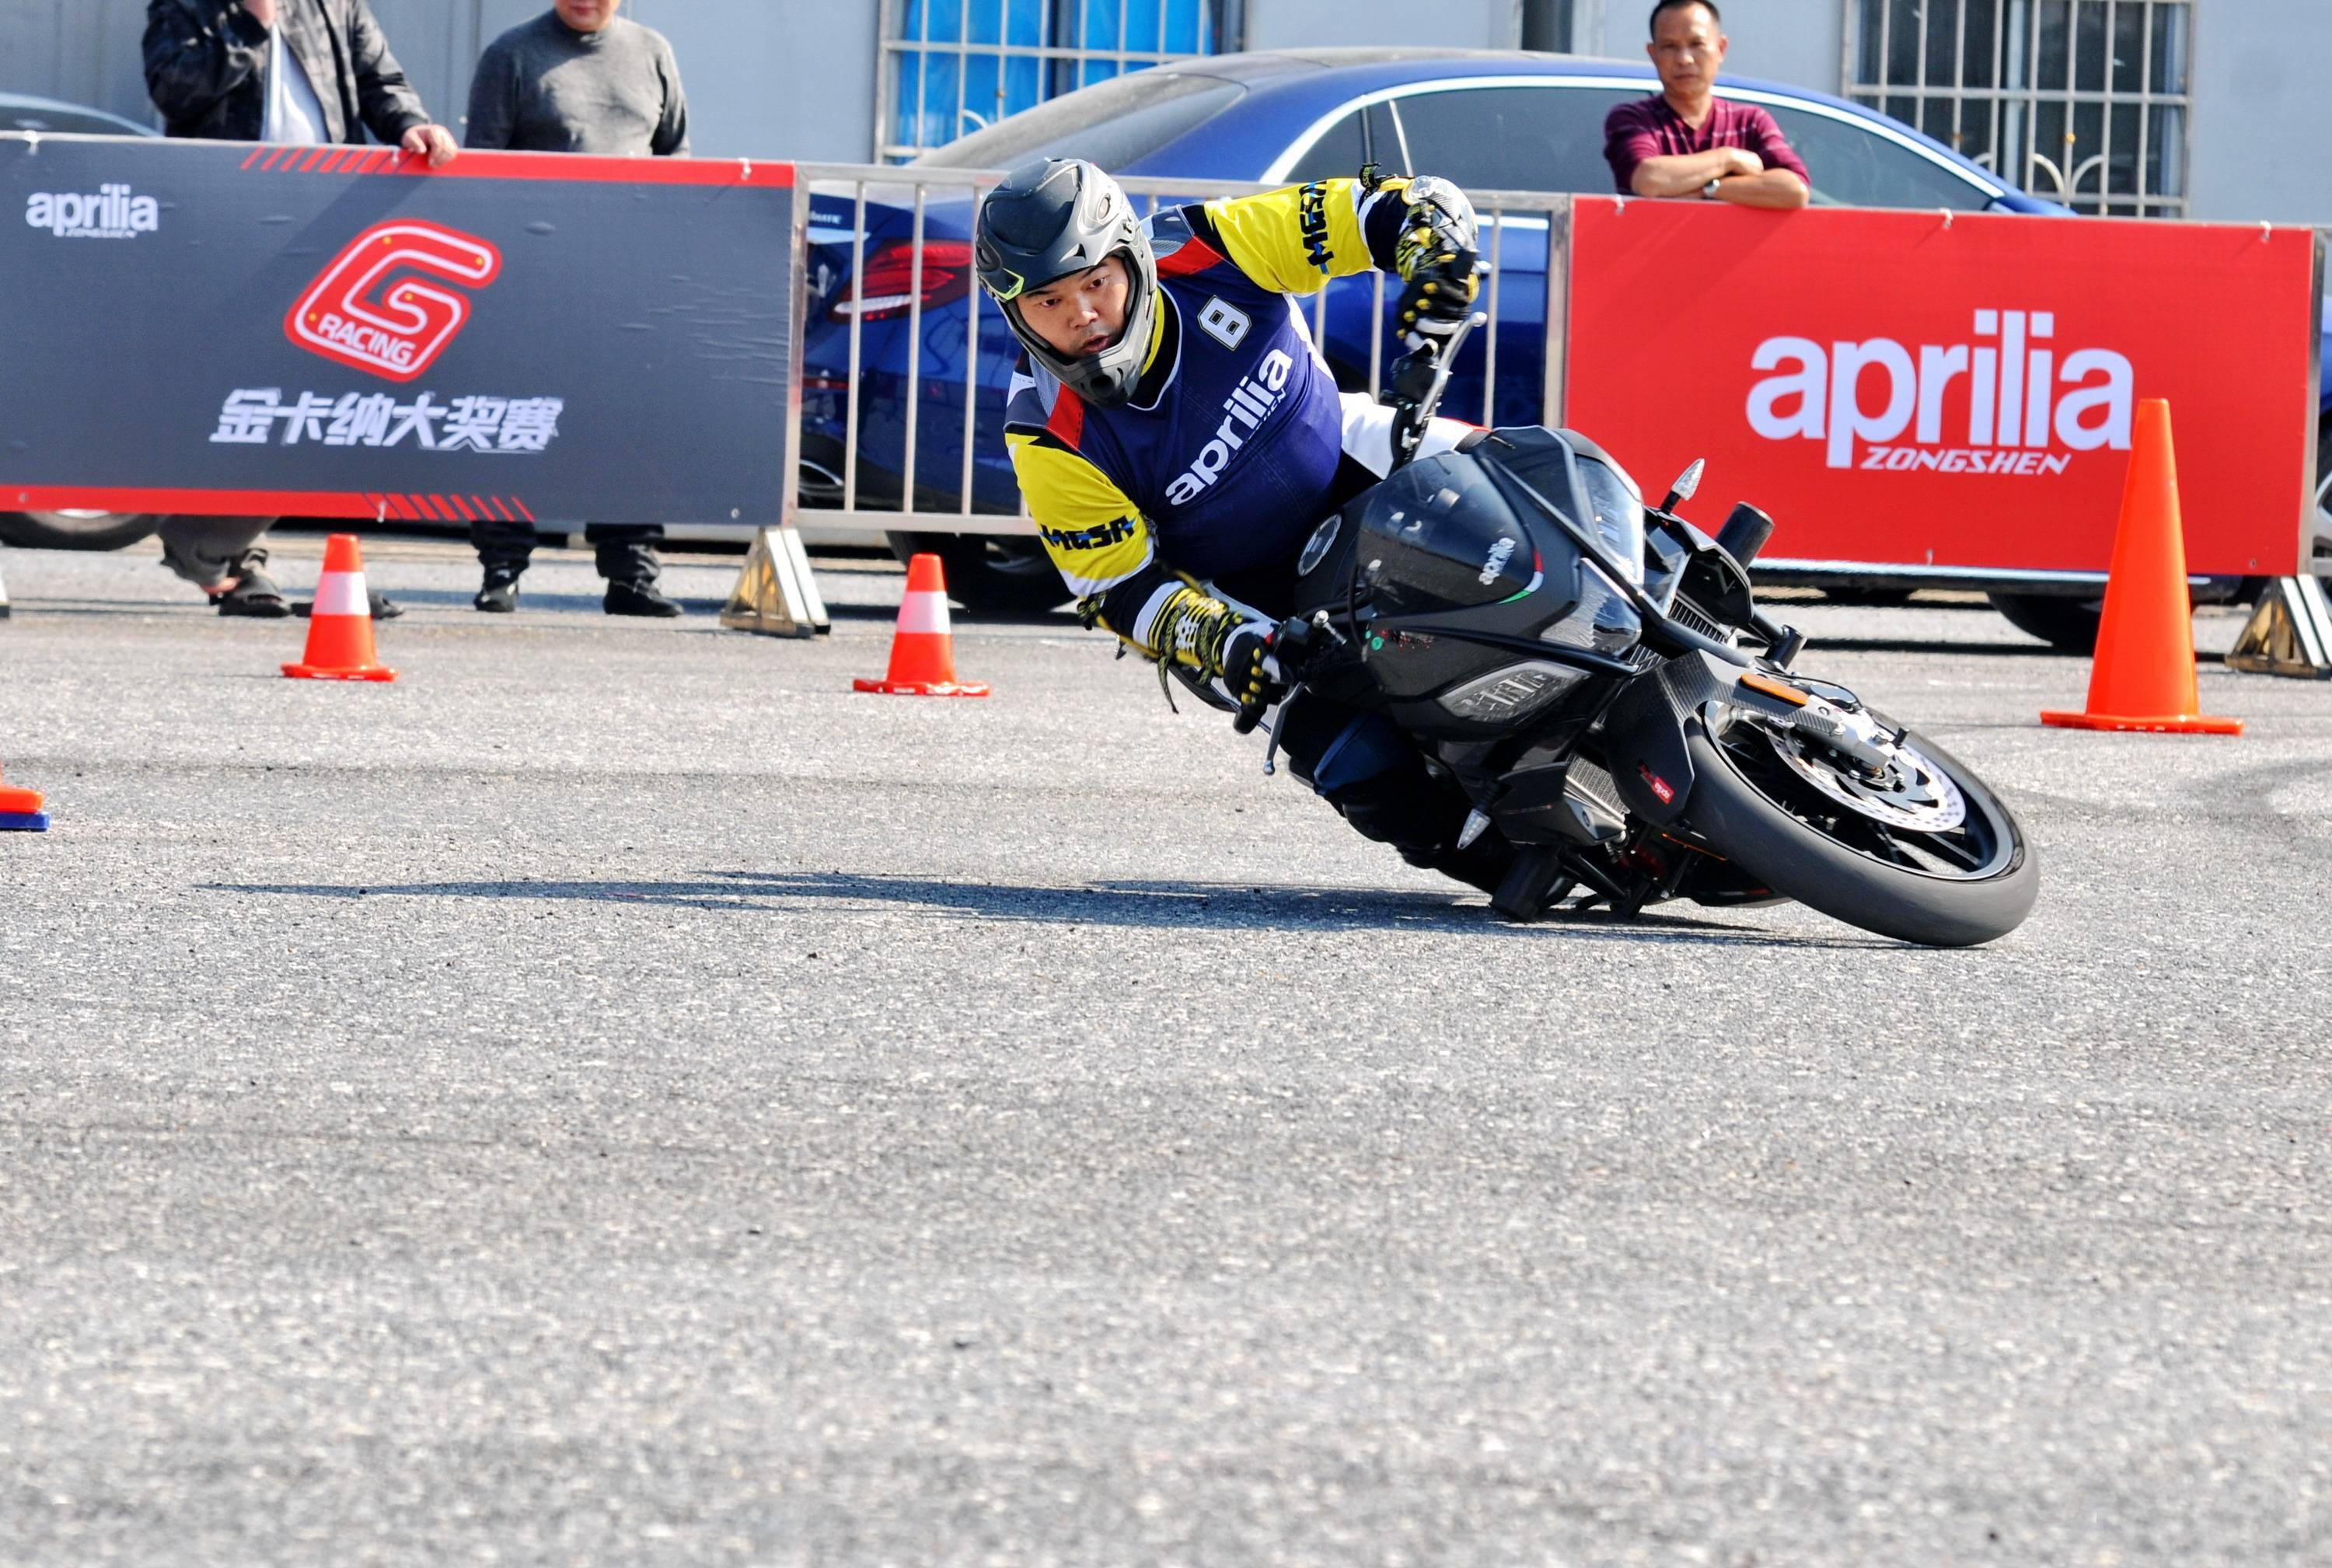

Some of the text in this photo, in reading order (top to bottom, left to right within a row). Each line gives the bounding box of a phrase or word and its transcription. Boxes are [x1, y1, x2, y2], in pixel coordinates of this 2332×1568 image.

[25, 183, 159, 237] aprilia
[317, 313, 415, 365] RACING
[1745, 309, 2134, 469] aprilia
[209, 387, 564, 452] 金卡纳大奖赛
[1165, 348, 1293, 506] aprilia
[1860, 446, 2072, 476] ZONGSHEN
